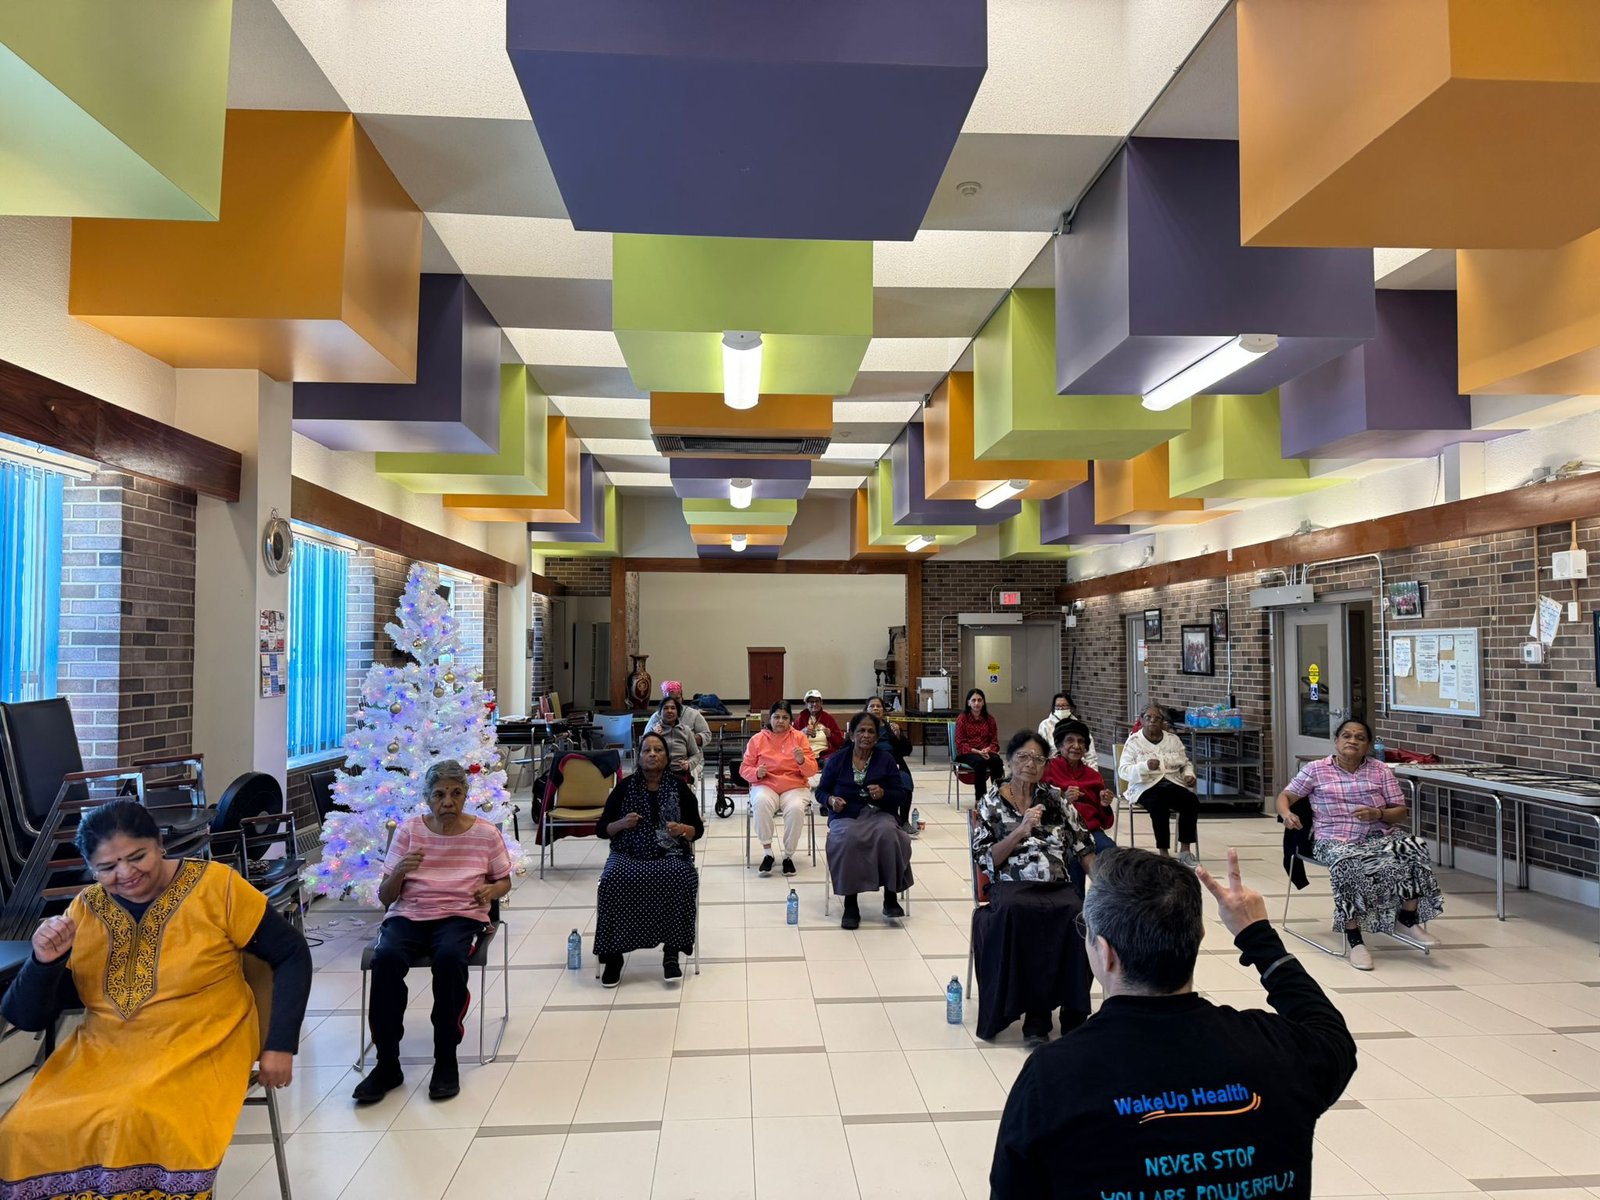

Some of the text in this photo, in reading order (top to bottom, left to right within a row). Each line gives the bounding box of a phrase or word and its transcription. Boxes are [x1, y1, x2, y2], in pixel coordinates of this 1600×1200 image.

[1114, 1083, 1249, 1115] WakeUp Health
[1145, 1145, 1255, 1177] NEVER STOP
